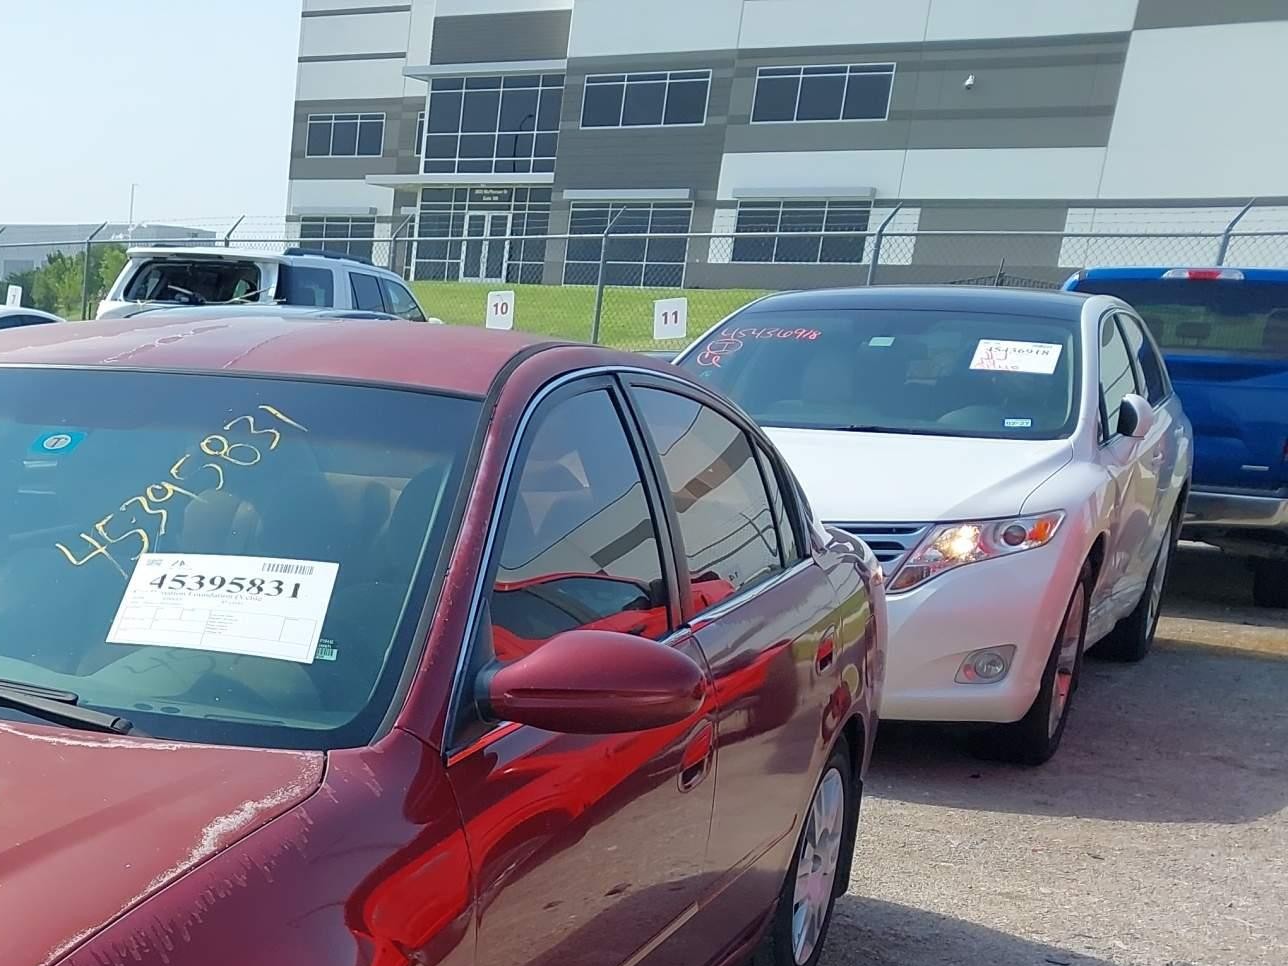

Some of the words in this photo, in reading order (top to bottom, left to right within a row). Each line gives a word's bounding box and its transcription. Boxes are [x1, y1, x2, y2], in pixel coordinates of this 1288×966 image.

[493, 302, 509, 316] 10
[661, 310, 680, 325] 11
[55, 404, 309, 580] 45395831
[149, 573, 302, 600] 45395831
